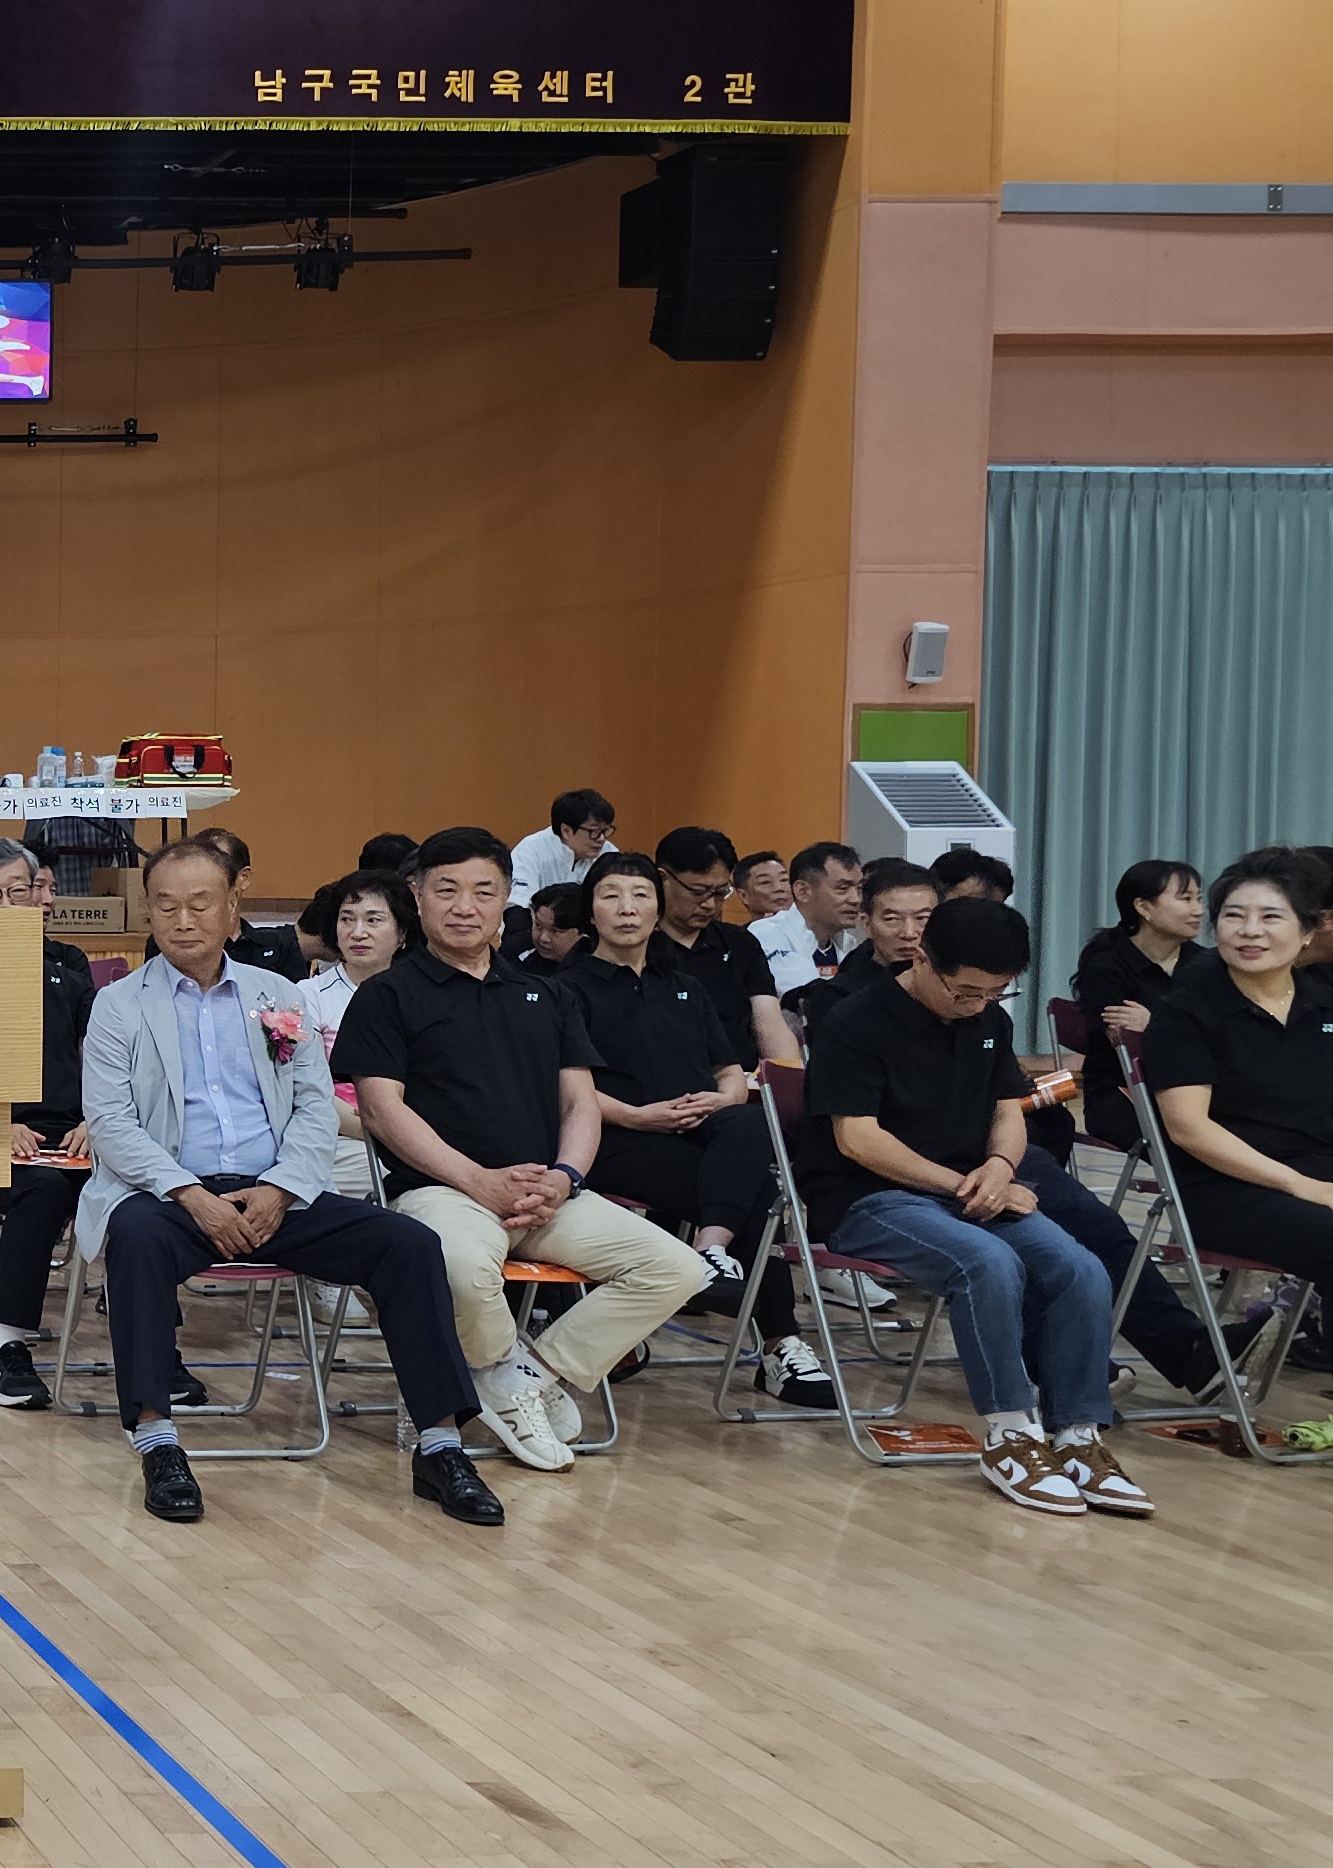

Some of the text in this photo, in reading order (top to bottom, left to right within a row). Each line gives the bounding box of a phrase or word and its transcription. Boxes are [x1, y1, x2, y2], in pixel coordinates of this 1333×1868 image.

[253, 69, 615, 104] 남구국민체육센터
[26, 795, 63, 809] 의료진
[69, 796, 101, 813] 착석
[108, 798, 141, 814] 불가
[147, 796, 183, 808] 의료진
[70, 908, 109, 920] TERRE
